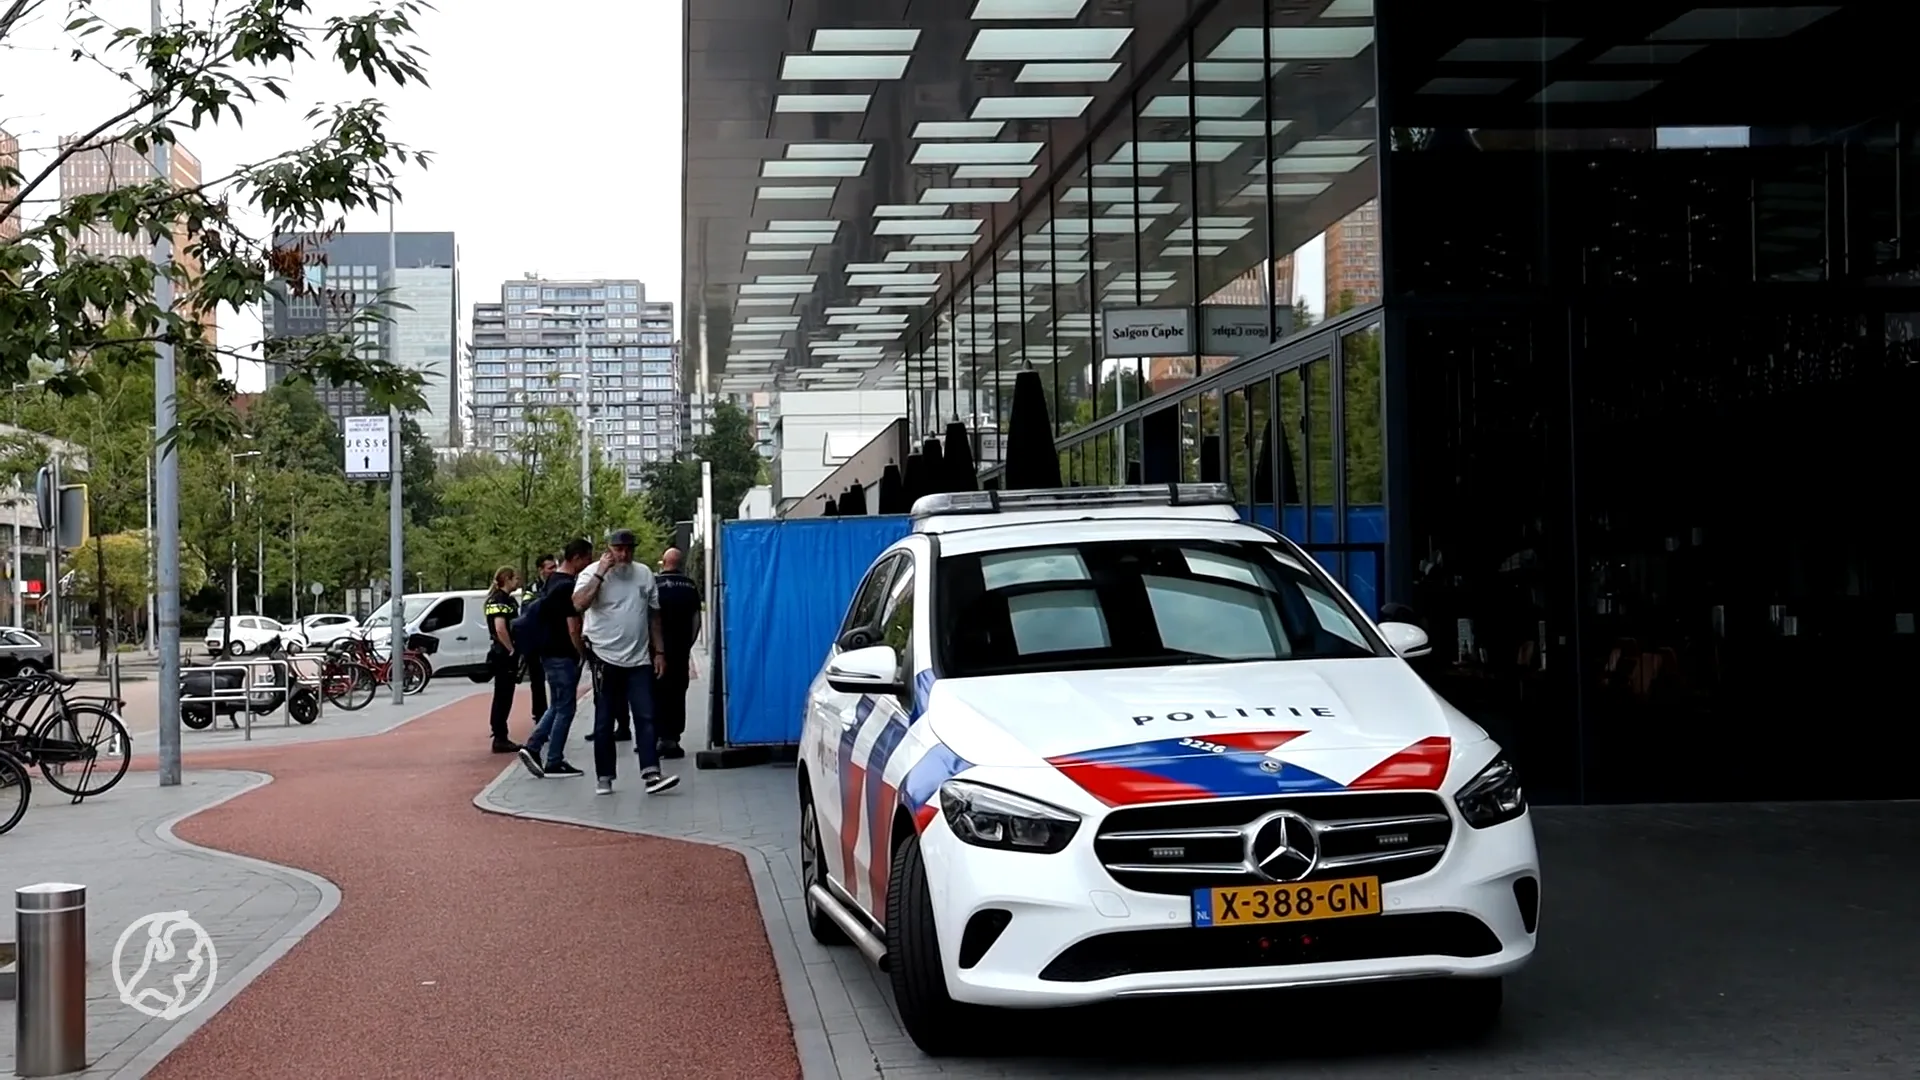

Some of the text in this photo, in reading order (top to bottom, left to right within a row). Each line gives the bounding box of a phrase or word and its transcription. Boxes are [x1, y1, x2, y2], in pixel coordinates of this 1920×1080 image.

[1132, 707, 1336, 726] POLITIE
[1178, 737, 1227, 753] 3226
[1196, 882, 1369, 921] NL X-388-GN
